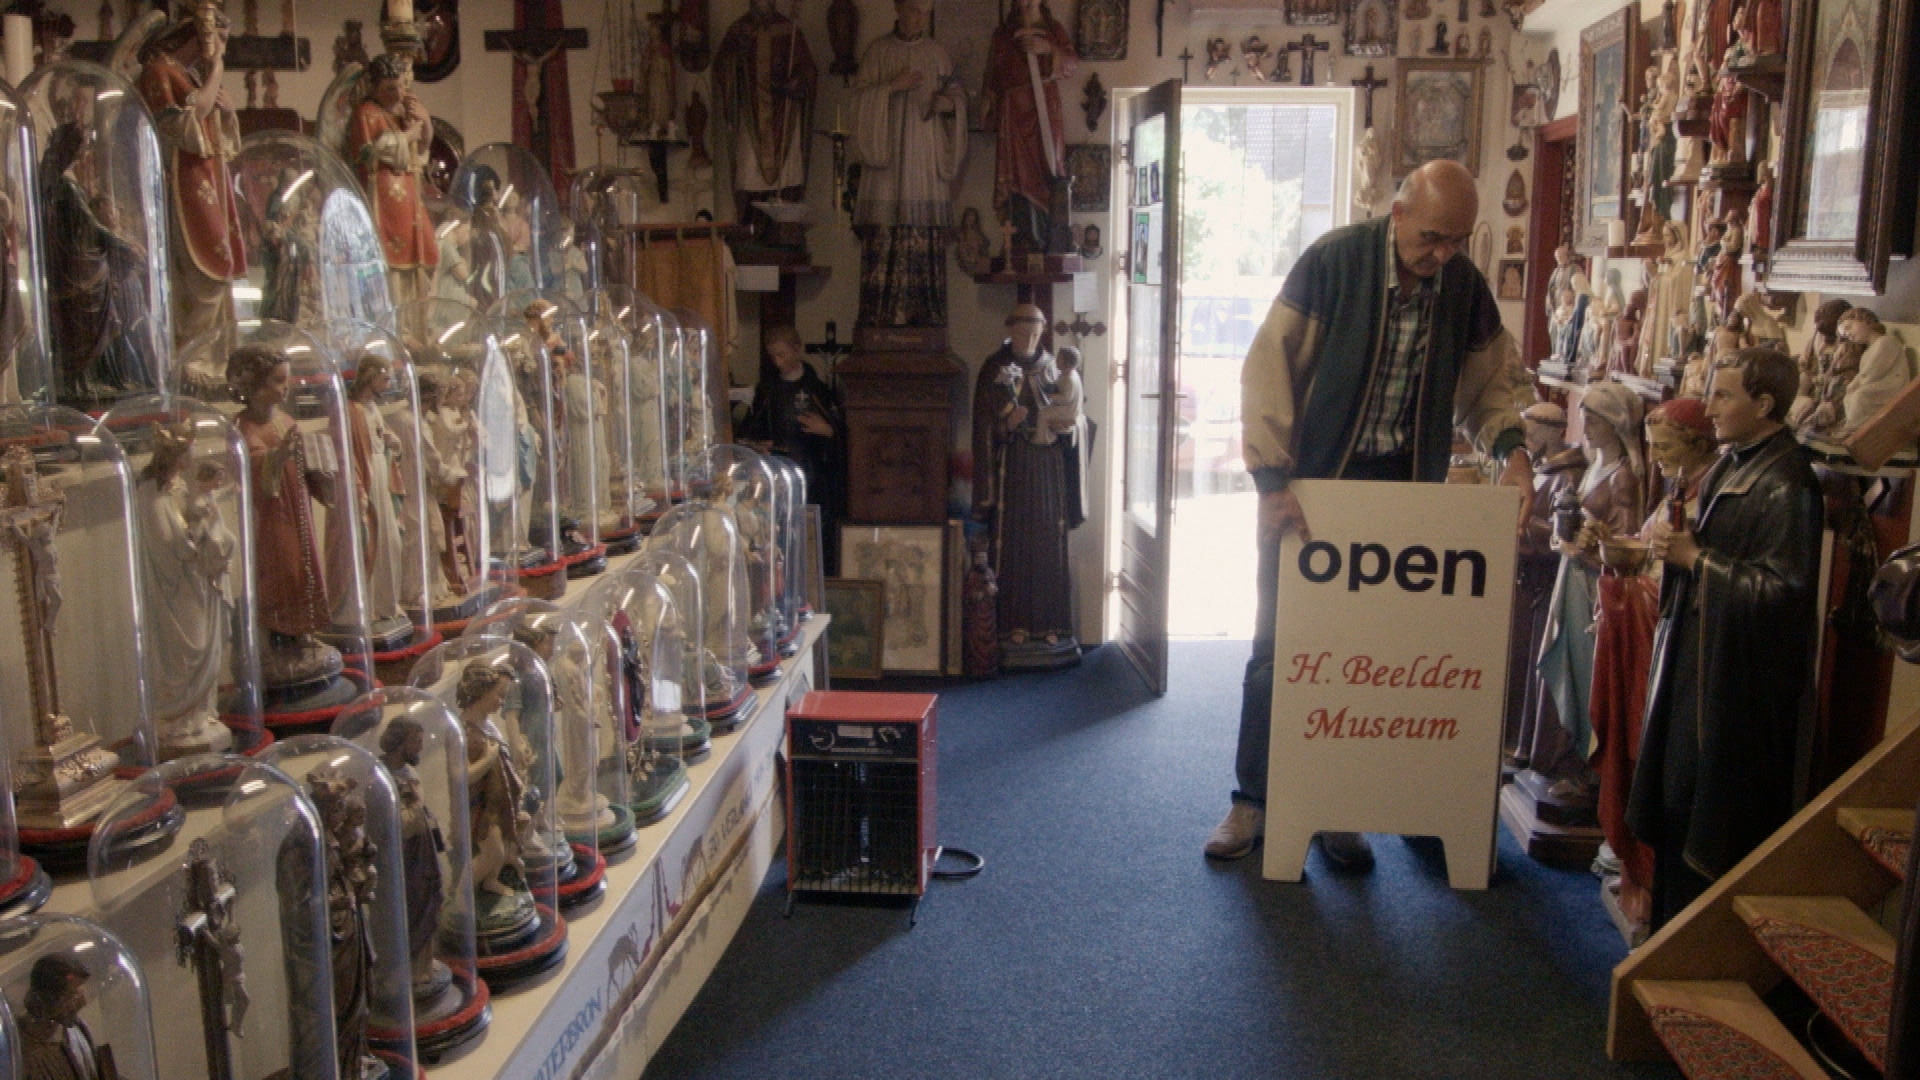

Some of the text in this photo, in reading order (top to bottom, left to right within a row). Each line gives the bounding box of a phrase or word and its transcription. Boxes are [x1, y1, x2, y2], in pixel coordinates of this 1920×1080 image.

[1298, 540, 1487, 597] open
[1287, 652, 1482, 690] H. Beelden
[1304, 706, 1461, 741] Museum
